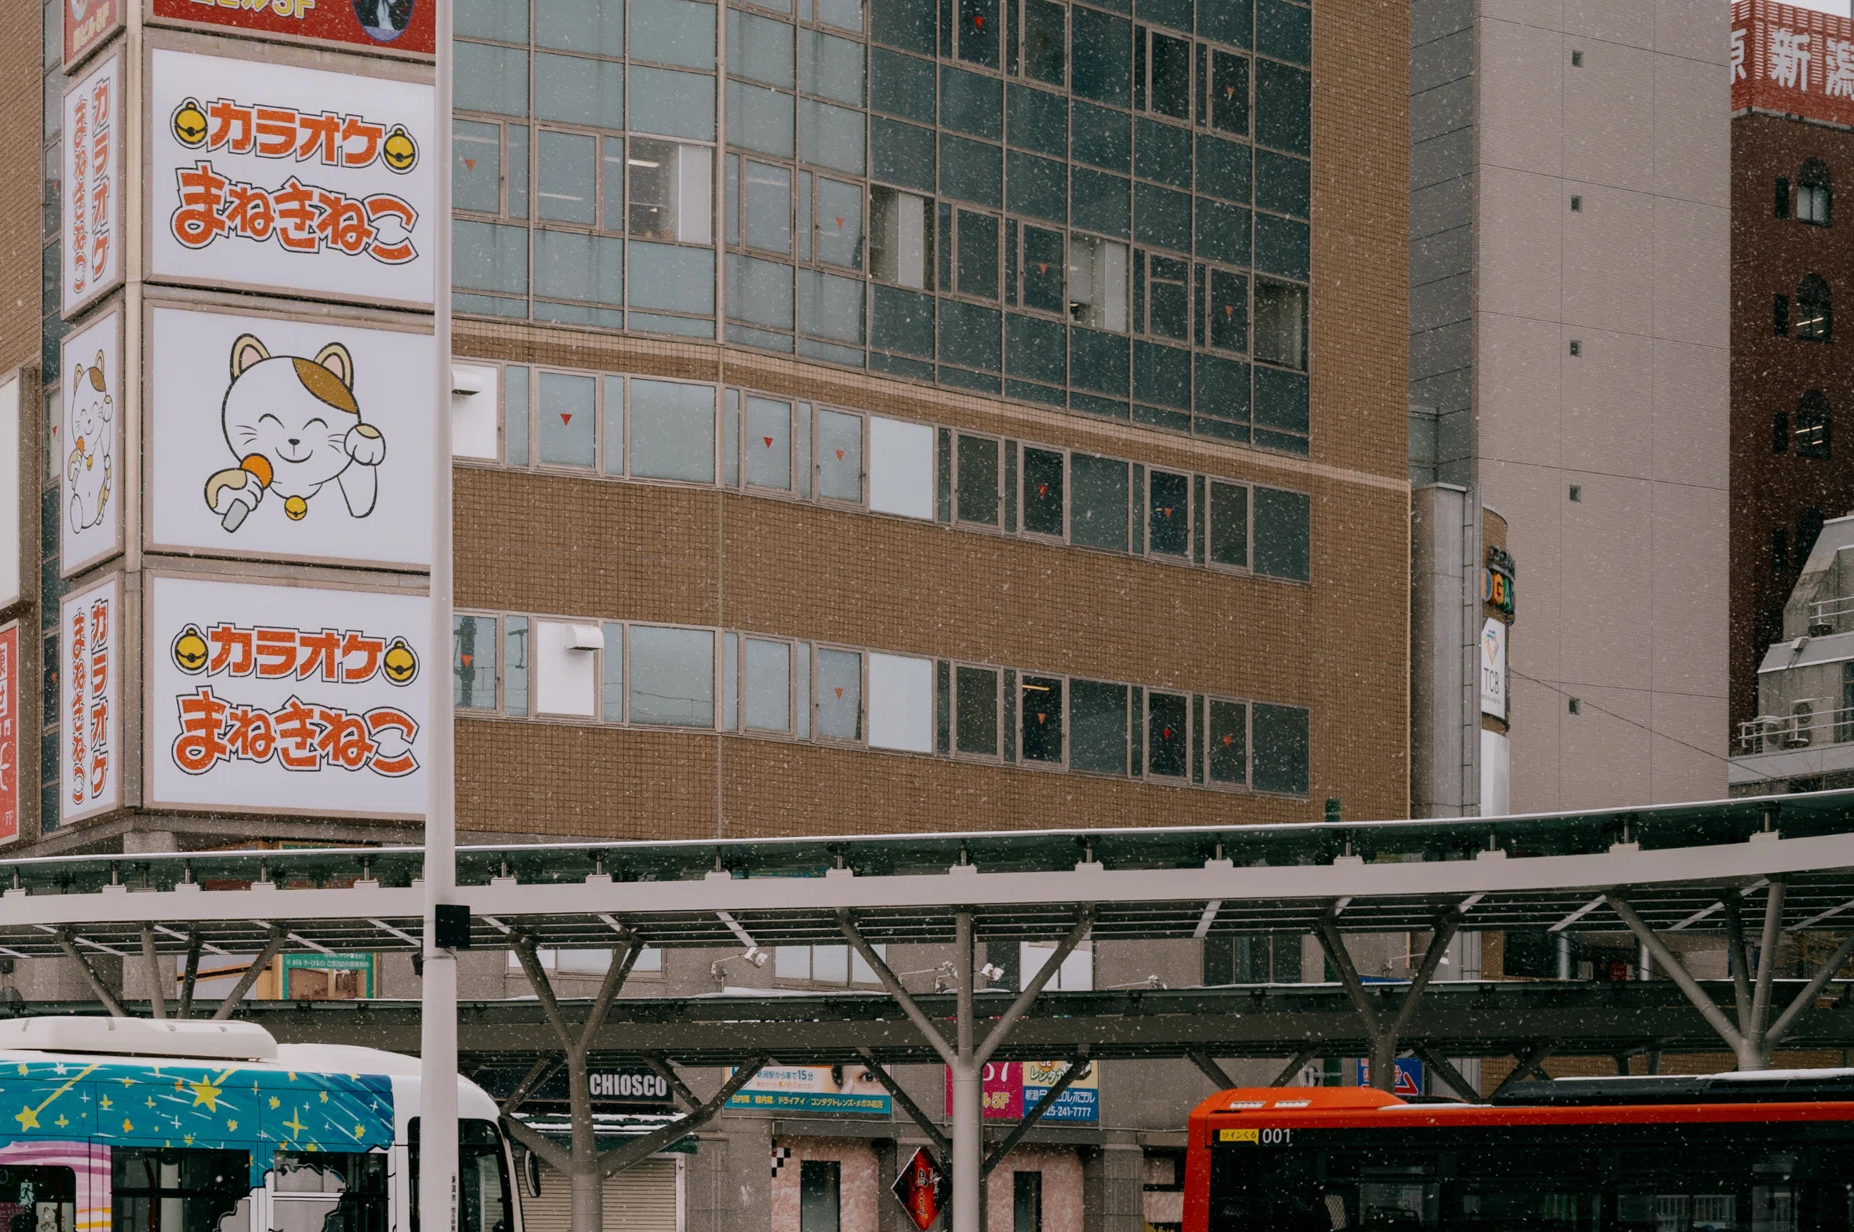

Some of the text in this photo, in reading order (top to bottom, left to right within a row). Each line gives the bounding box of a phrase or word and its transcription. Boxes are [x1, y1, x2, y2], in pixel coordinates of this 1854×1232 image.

[207, 99, 386, 168] カラオケ
[73, 95, 87, 294] まねきねこ
[92, 77, 110, 283] カラオケ
[171, 162, 418, 264] まねきねこ
[207, 622, 386, 684] カラオケ
[1483, 667, 1500, 695] TCB
[72, 607, 86, 806] まねきねこ
[91, 599, 109, 800] カラオケ
[172, 686, 419, 777] まねきねこ
[589, 1073, 667, 1097] CHIOSCO
[1043, 1105, 1091, 1117] 25-241-7777
[1262, 1128, 1291, 1144] 001
